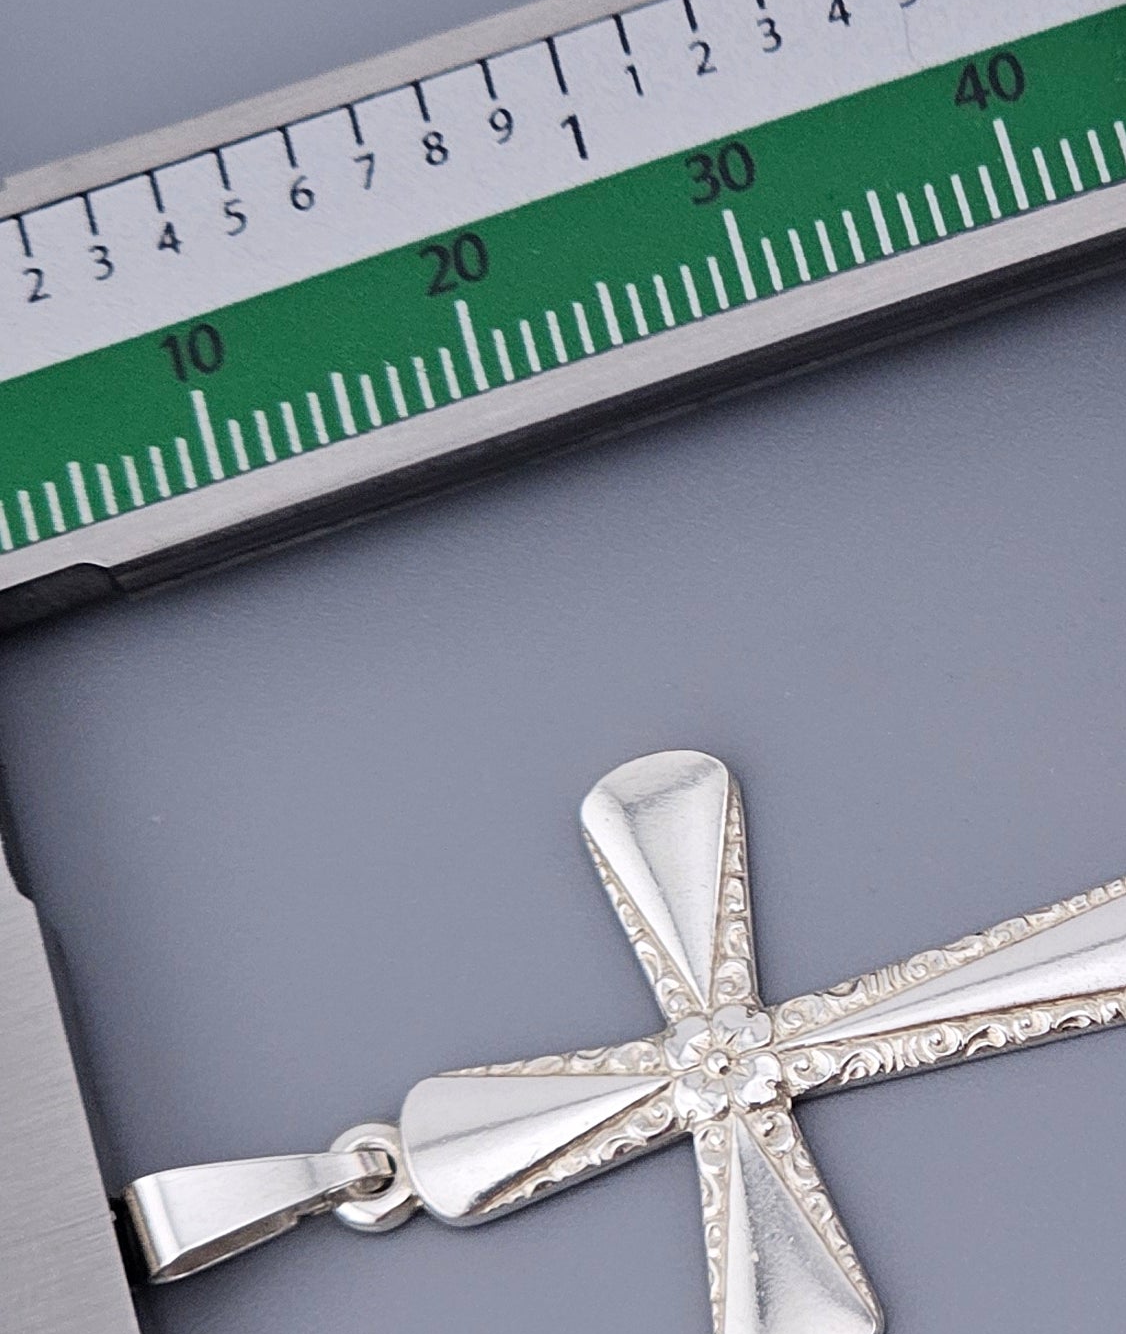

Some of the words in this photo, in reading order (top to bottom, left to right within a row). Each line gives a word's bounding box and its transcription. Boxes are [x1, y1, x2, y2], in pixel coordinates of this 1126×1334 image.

[26, 268, 51, 303] 2
[91, 245, 115, 281] 3
[158, 223, 182, 255] 4
[223, 199, 248, 237] 5
[289, 175, 316, 212] 6
[354, 153, 377, 190] 7
[422, 131, 450, 167] 8
[488, 107, 515, 144] 9
[560, 114, 589, 161] 1
[624, 64, 645, 97] 1
[688, 40, 718, 76] 2
[756, 16, 784, 54] 3
[159, 323, 226, 383] 10
[418, 231, 491, 299] 20
[684, 140, 758, 206] 30
[953, 51, 1027, 112] 40
